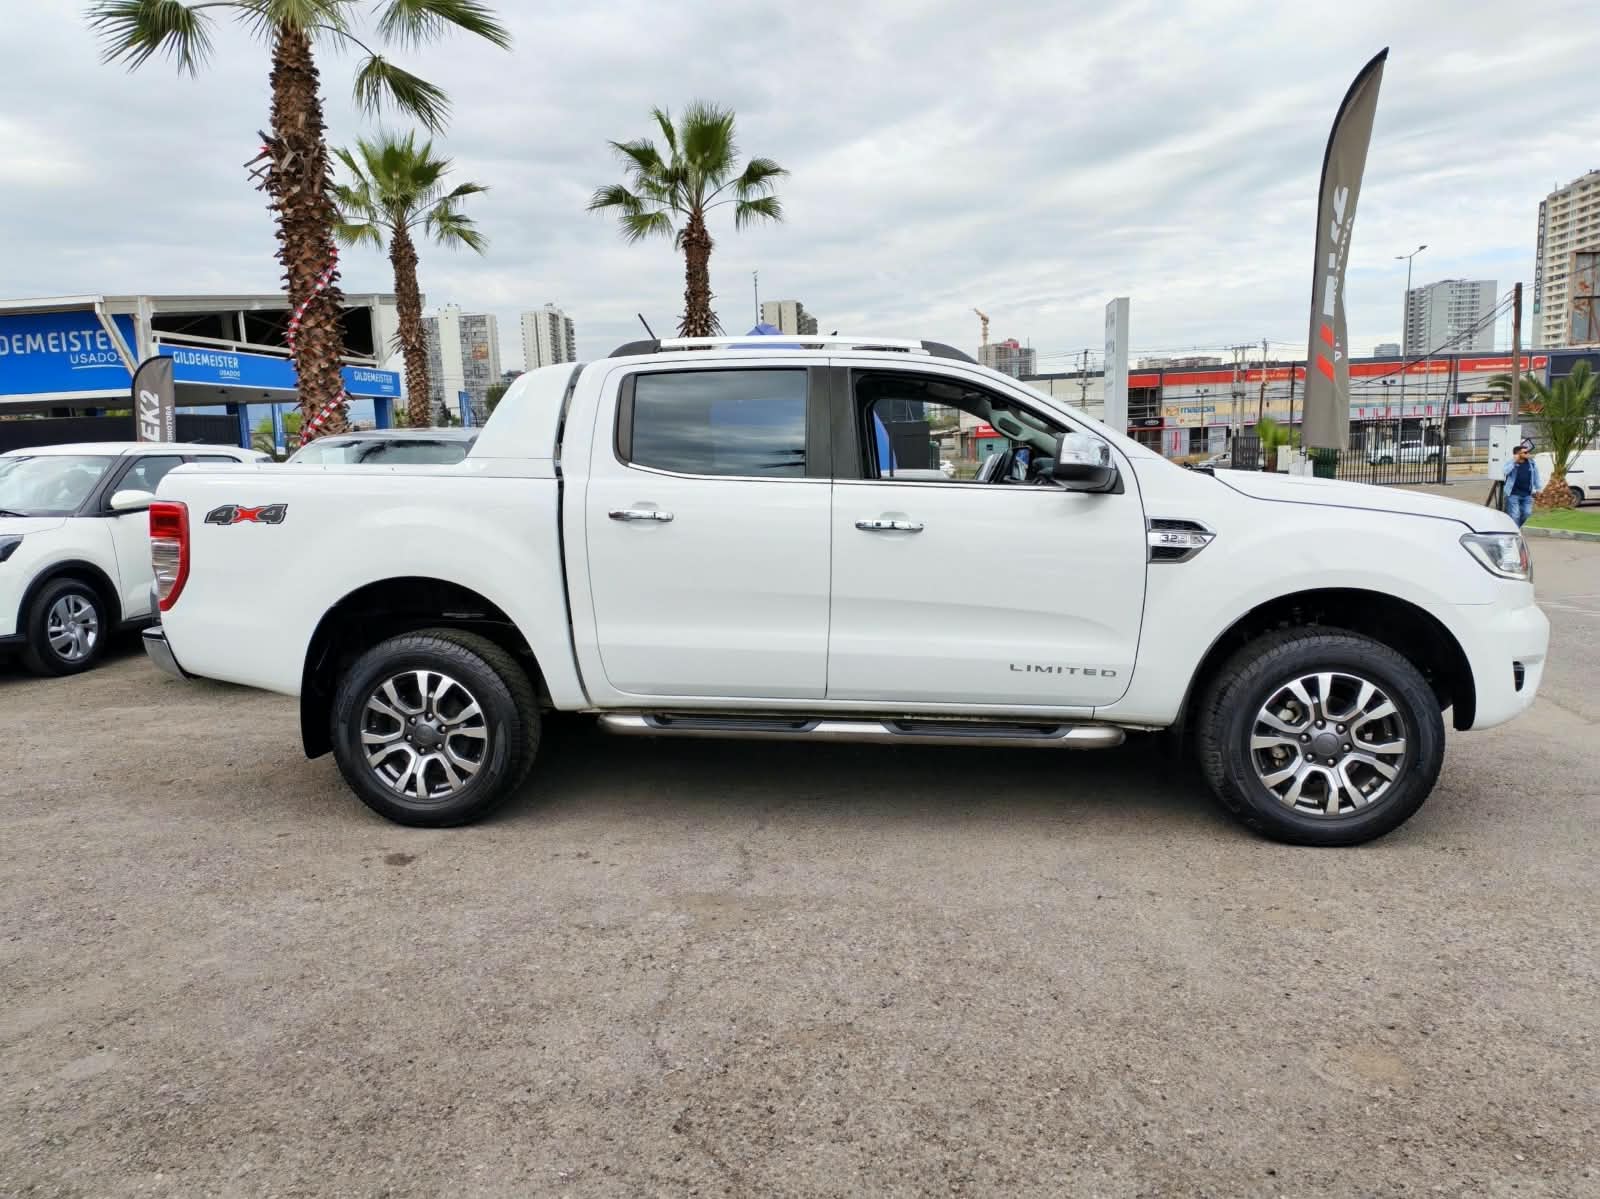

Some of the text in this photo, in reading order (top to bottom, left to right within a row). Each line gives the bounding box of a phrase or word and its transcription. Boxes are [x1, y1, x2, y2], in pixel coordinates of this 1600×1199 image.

[173, 351, 239, 369] GILDEMEISTER
[219, 369, 240, 377] USADOS
[1009, 663, 1117, 678] LIMITED
